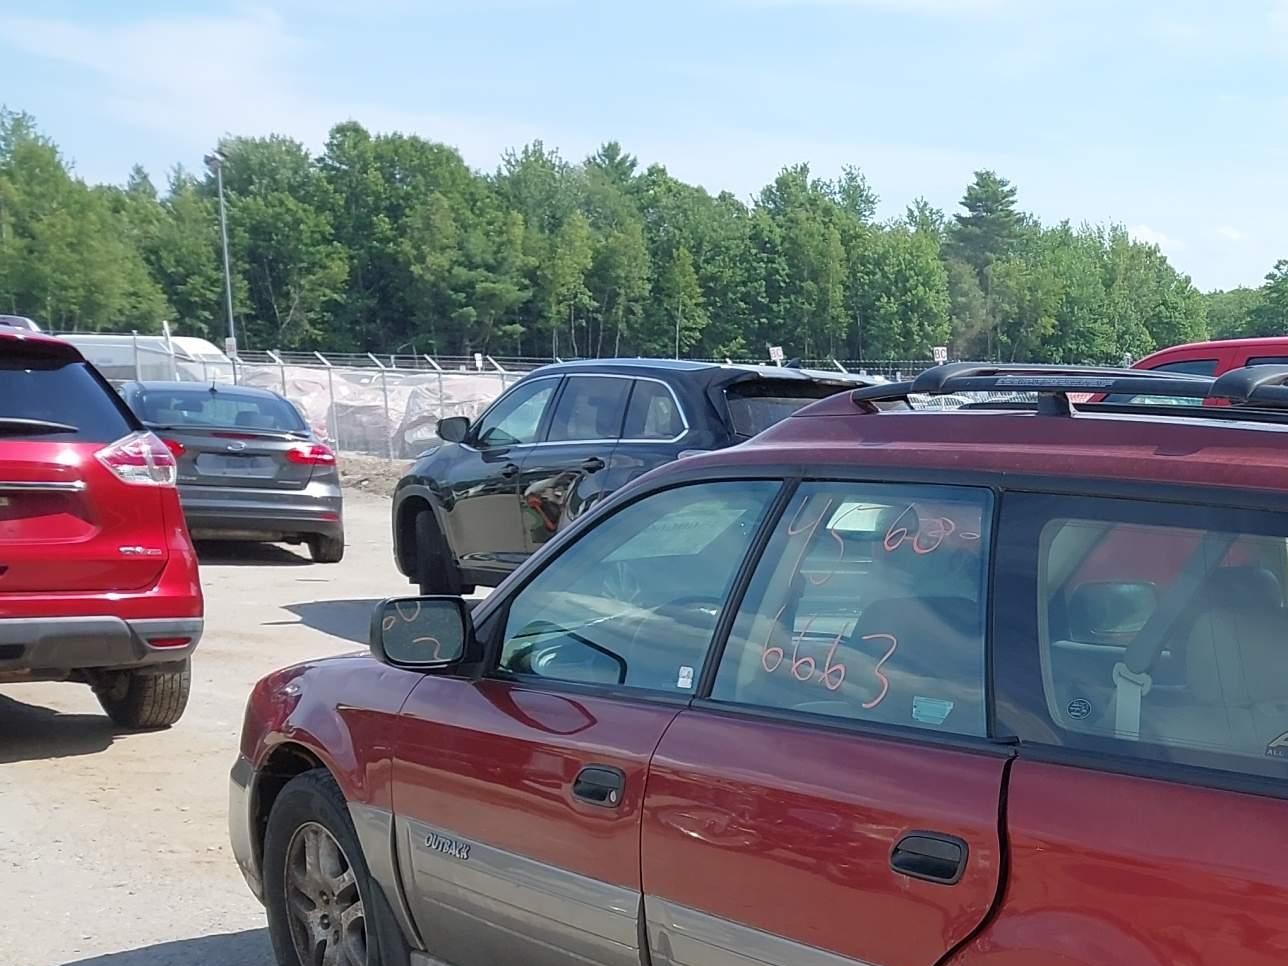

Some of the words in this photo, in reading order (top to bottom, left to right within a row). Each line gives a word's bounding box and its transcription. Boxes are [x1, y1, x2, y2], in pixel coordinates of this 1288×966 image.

[762, 604, 897, 709] 6663
[1266, 749, 1284, 757] ALL
[424, 832, 471, 860] OUTBACK
